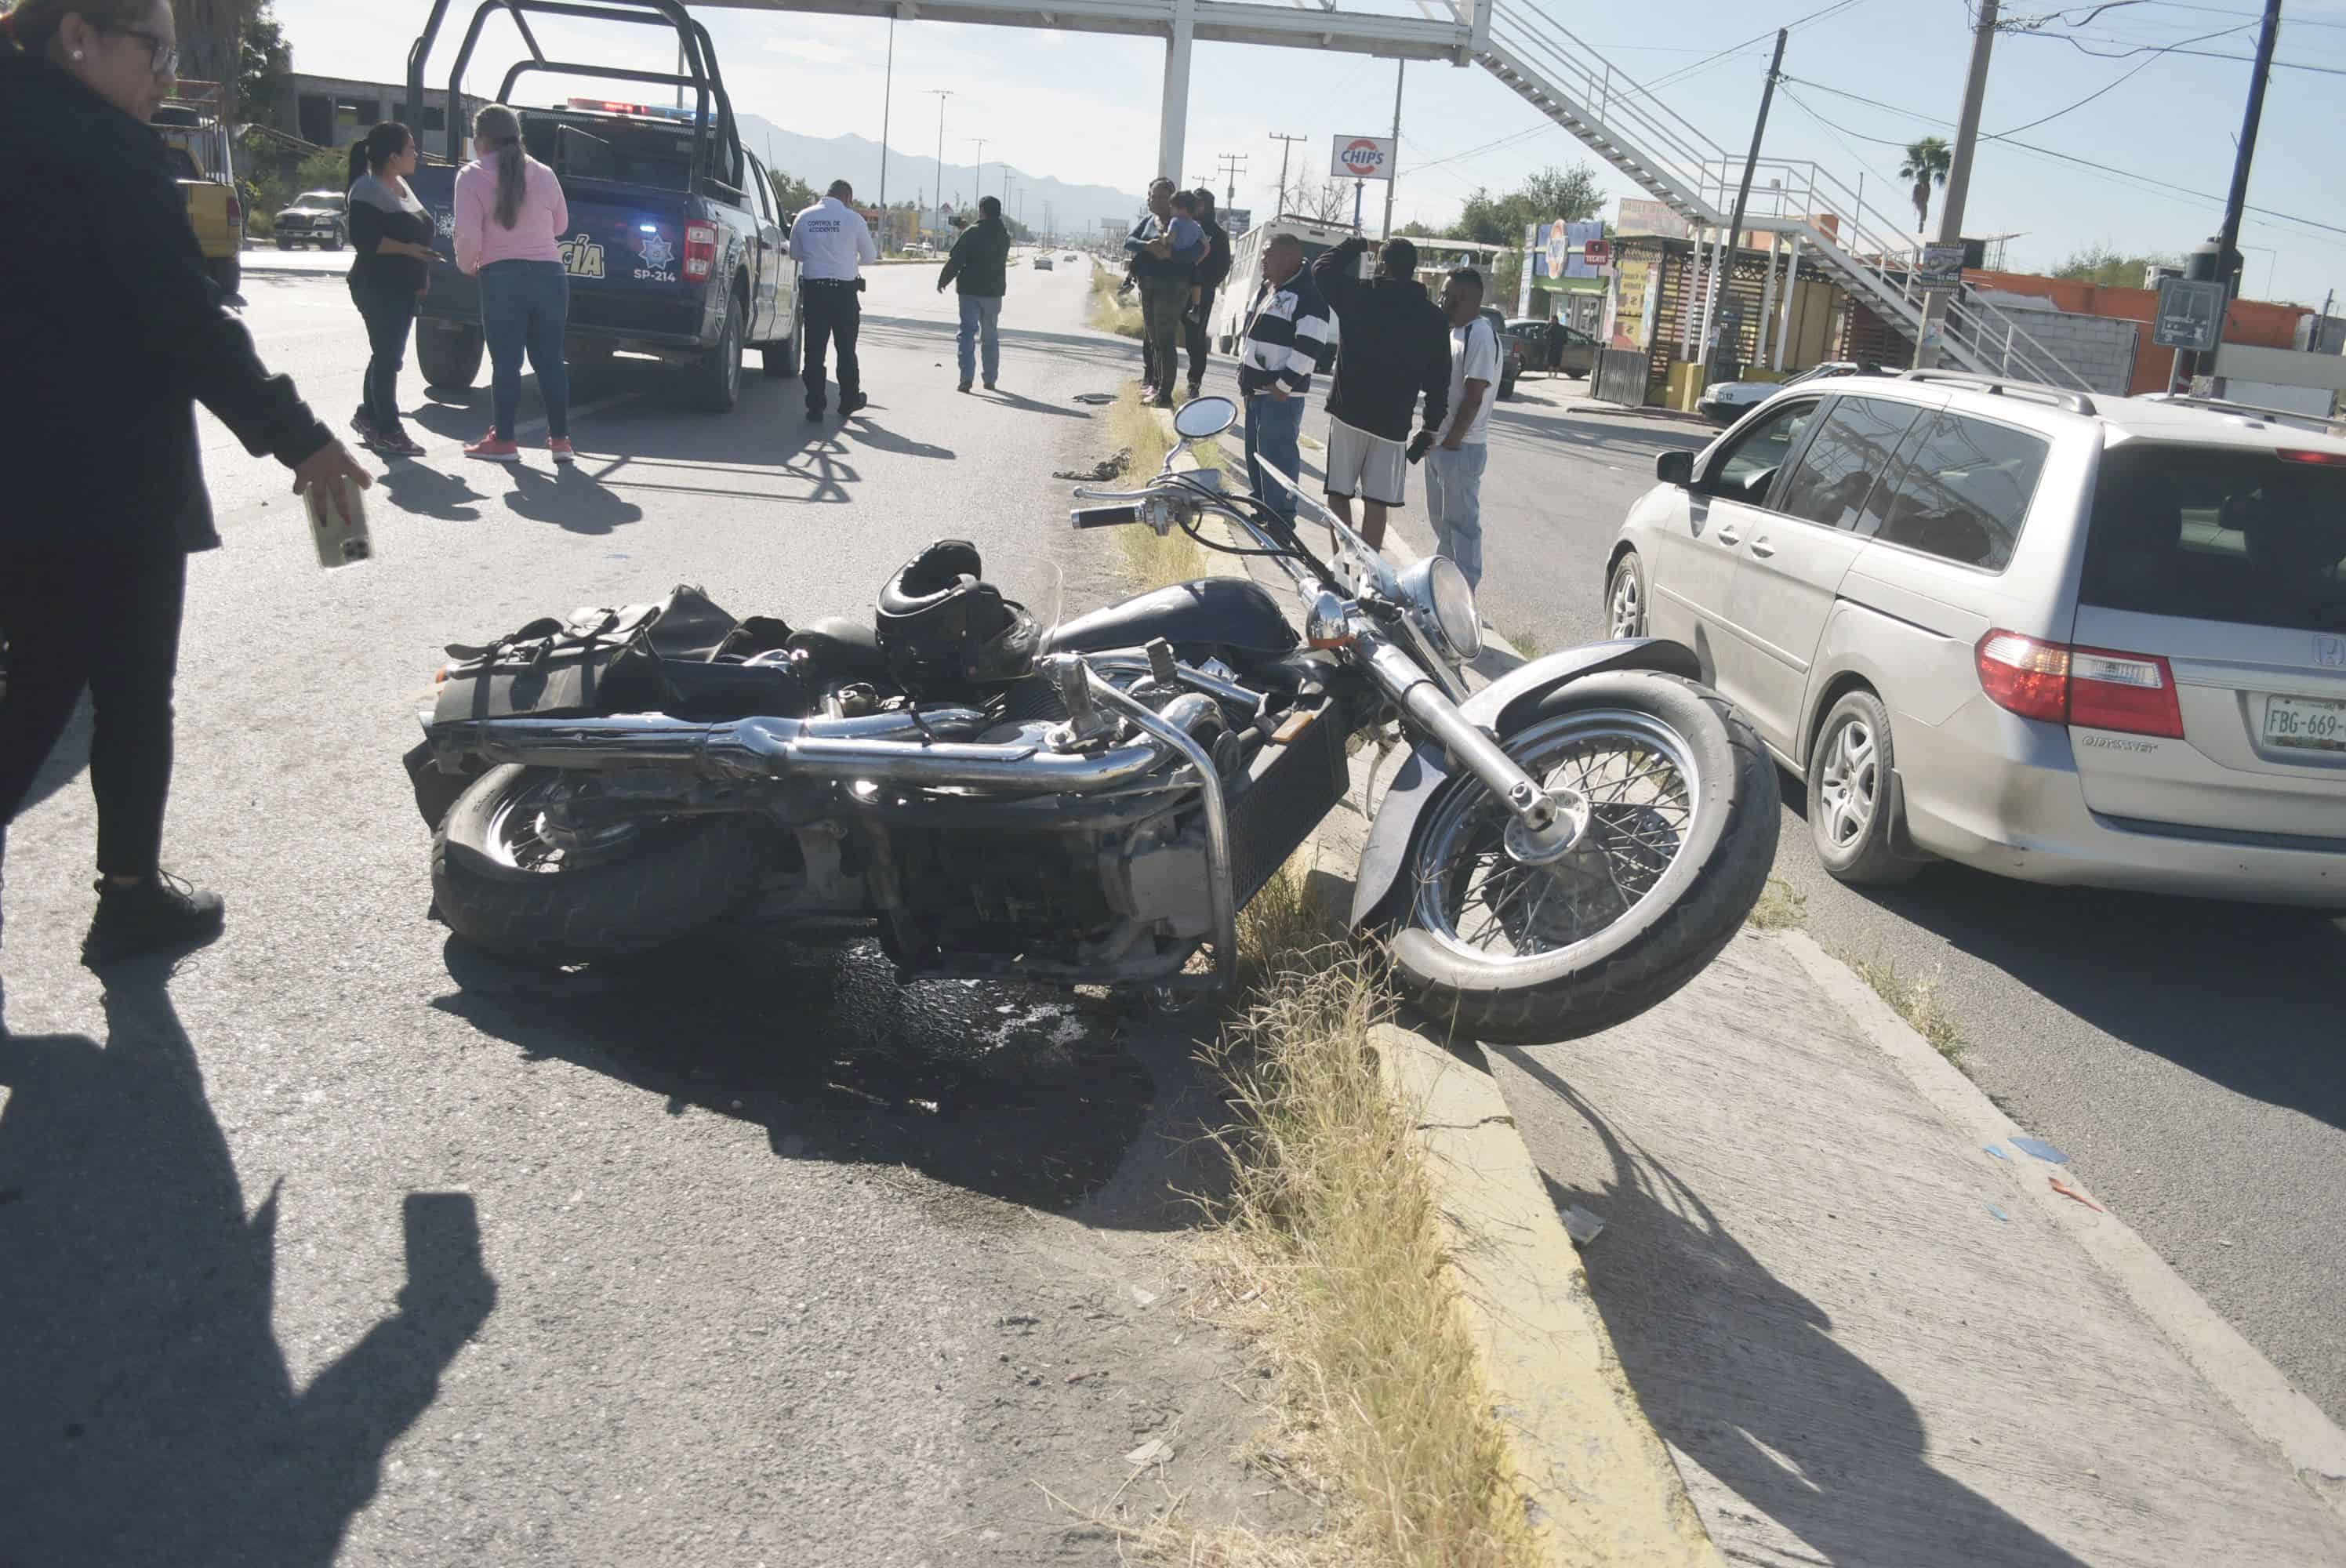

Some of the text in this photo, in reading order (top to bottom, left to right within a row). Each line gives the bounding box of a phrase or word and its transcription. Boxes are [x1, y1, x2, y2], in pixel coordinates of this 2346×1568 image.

[557, 234, 605, 278] CÍA
[634, 269, 676, 283] SP-214
[2269, 709, 2346, 735] FBG-669-
